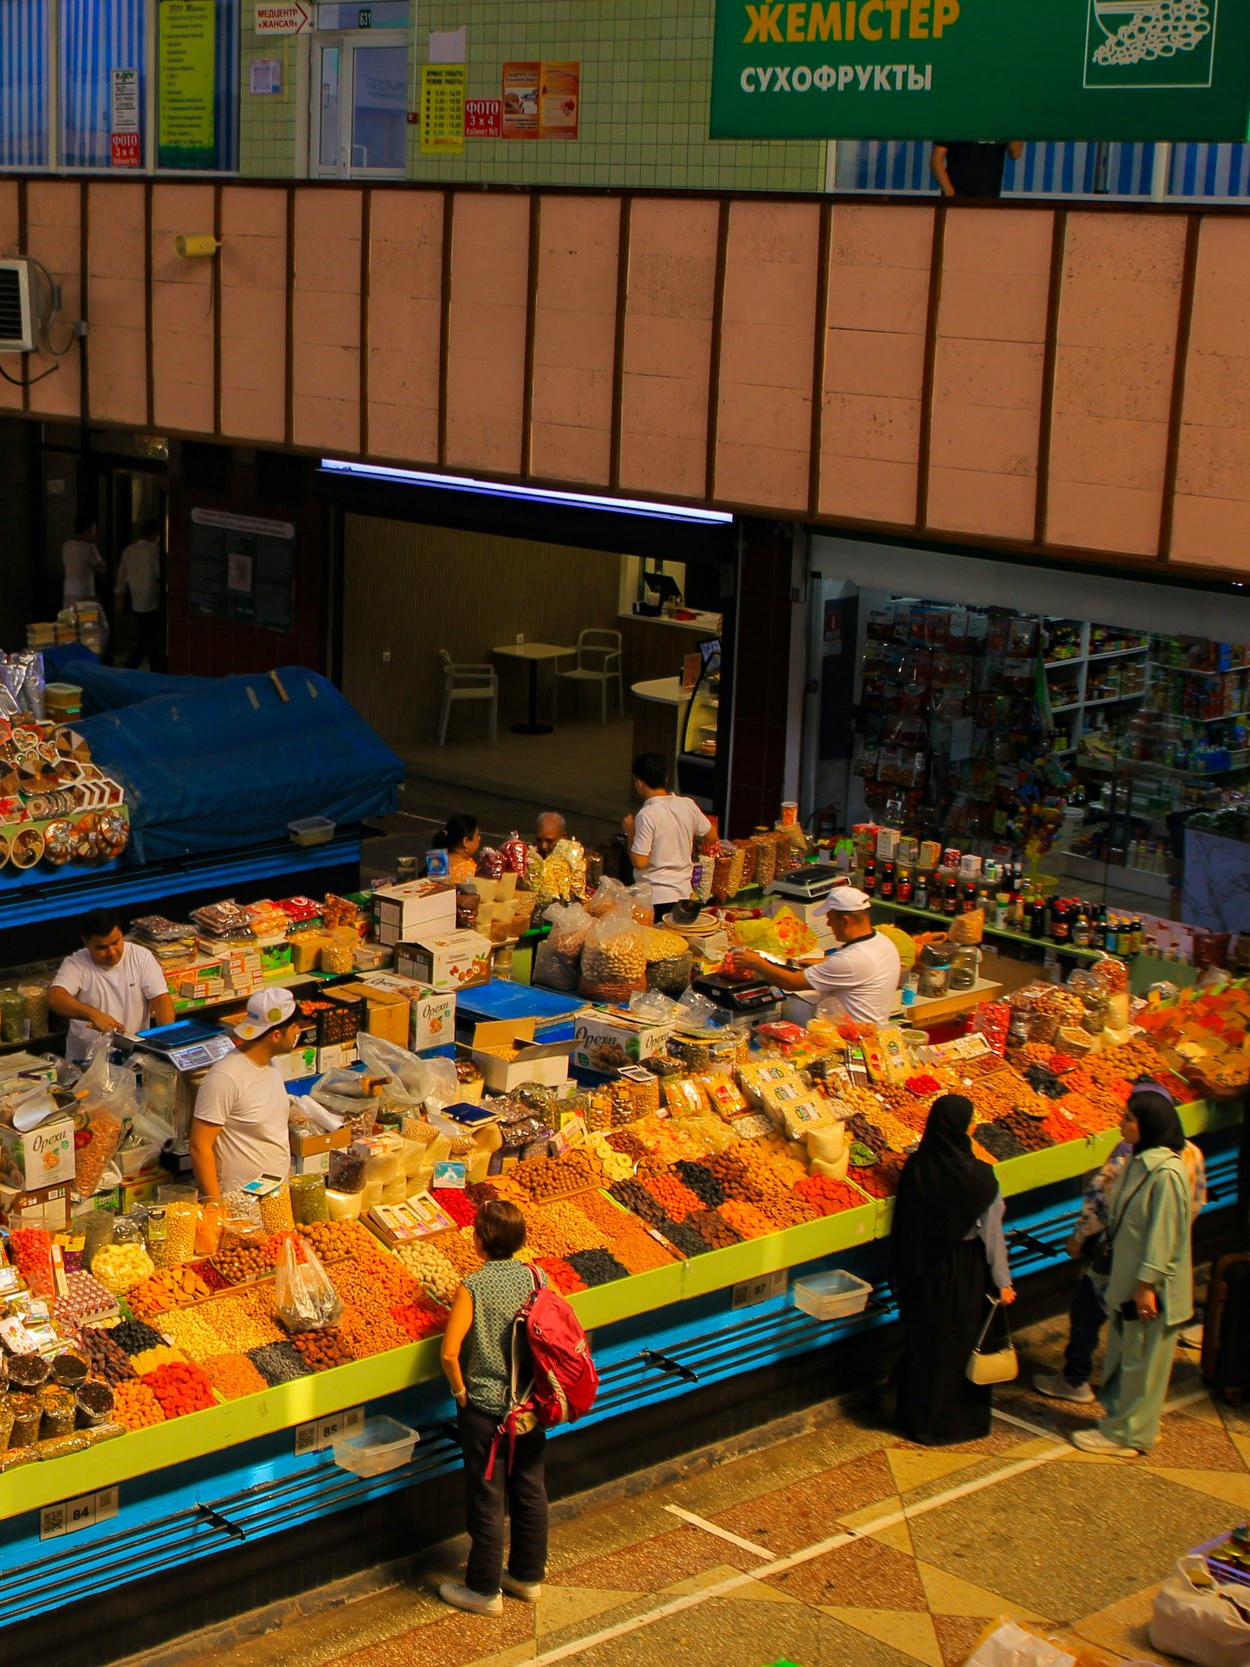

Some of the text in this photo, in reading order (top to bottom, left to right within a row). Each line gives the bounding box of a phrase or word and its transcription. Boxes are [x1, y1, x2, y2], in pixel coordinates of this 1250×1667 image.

[258, 9, 298, 18] МЕДЦЕНТР
[743, 0, 960, 43] ЖЕМІСТЕР
[740, 65, 932, 92] СУХОФРУКТЫ
[466, 101, 499, 115] ФОТО
[470, 115, 476, 126] 3
[487, 115, 494, 126] 4
[112, 135, 138, 147] ФОТО
[115, 148, 121, 157] 3
[129, 147, 135, 156] 4
[423, 1001, 449, 1020] Орехи
[33, 1130, 67, 1154] Орехи
[323, 1424, 337, 1437] 85
[72, 1507, 89, 1521] 84
